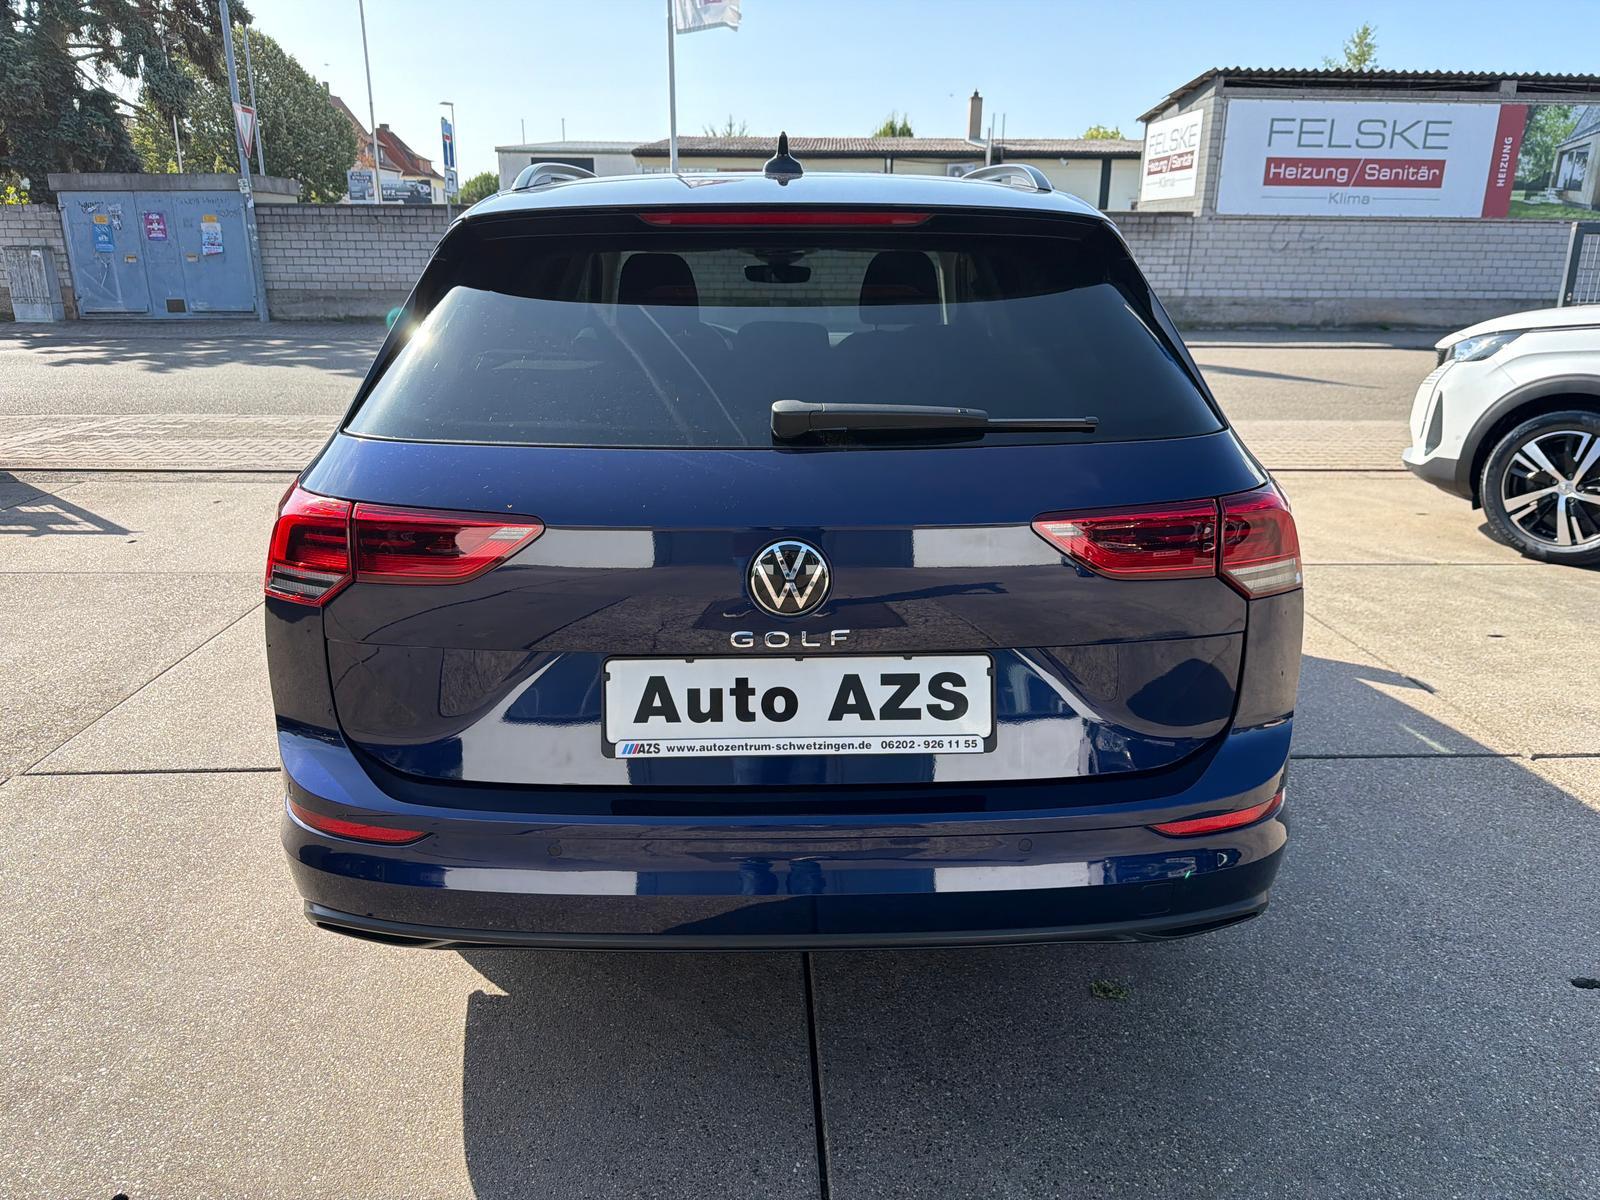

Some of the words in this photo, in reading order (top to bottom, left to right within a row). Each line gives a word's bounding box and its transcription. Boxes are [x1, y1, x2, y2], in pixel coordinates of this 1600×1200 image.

[1148, 123, 1198, 156] FELSKE
[1267, 117, 1452, 150] FELSKE
[1269, 163, 1349, 183] Heizung
[1364, 163, 1439, 182] Sanitär
[1496, 136, 1513, 187] HEIZUNG
[1328, 192, 1370, 205] Klima
[730, 629, 850, 648] GOLF
[633, 675, 799, 723] Auto
[828, 671, 969, 721] AZS
[637, 743, 661, 755] AZS
[666, 740, 872, 753] www.autozentrum-schwetzingen.de
[962, 739, 978, 749] 55
